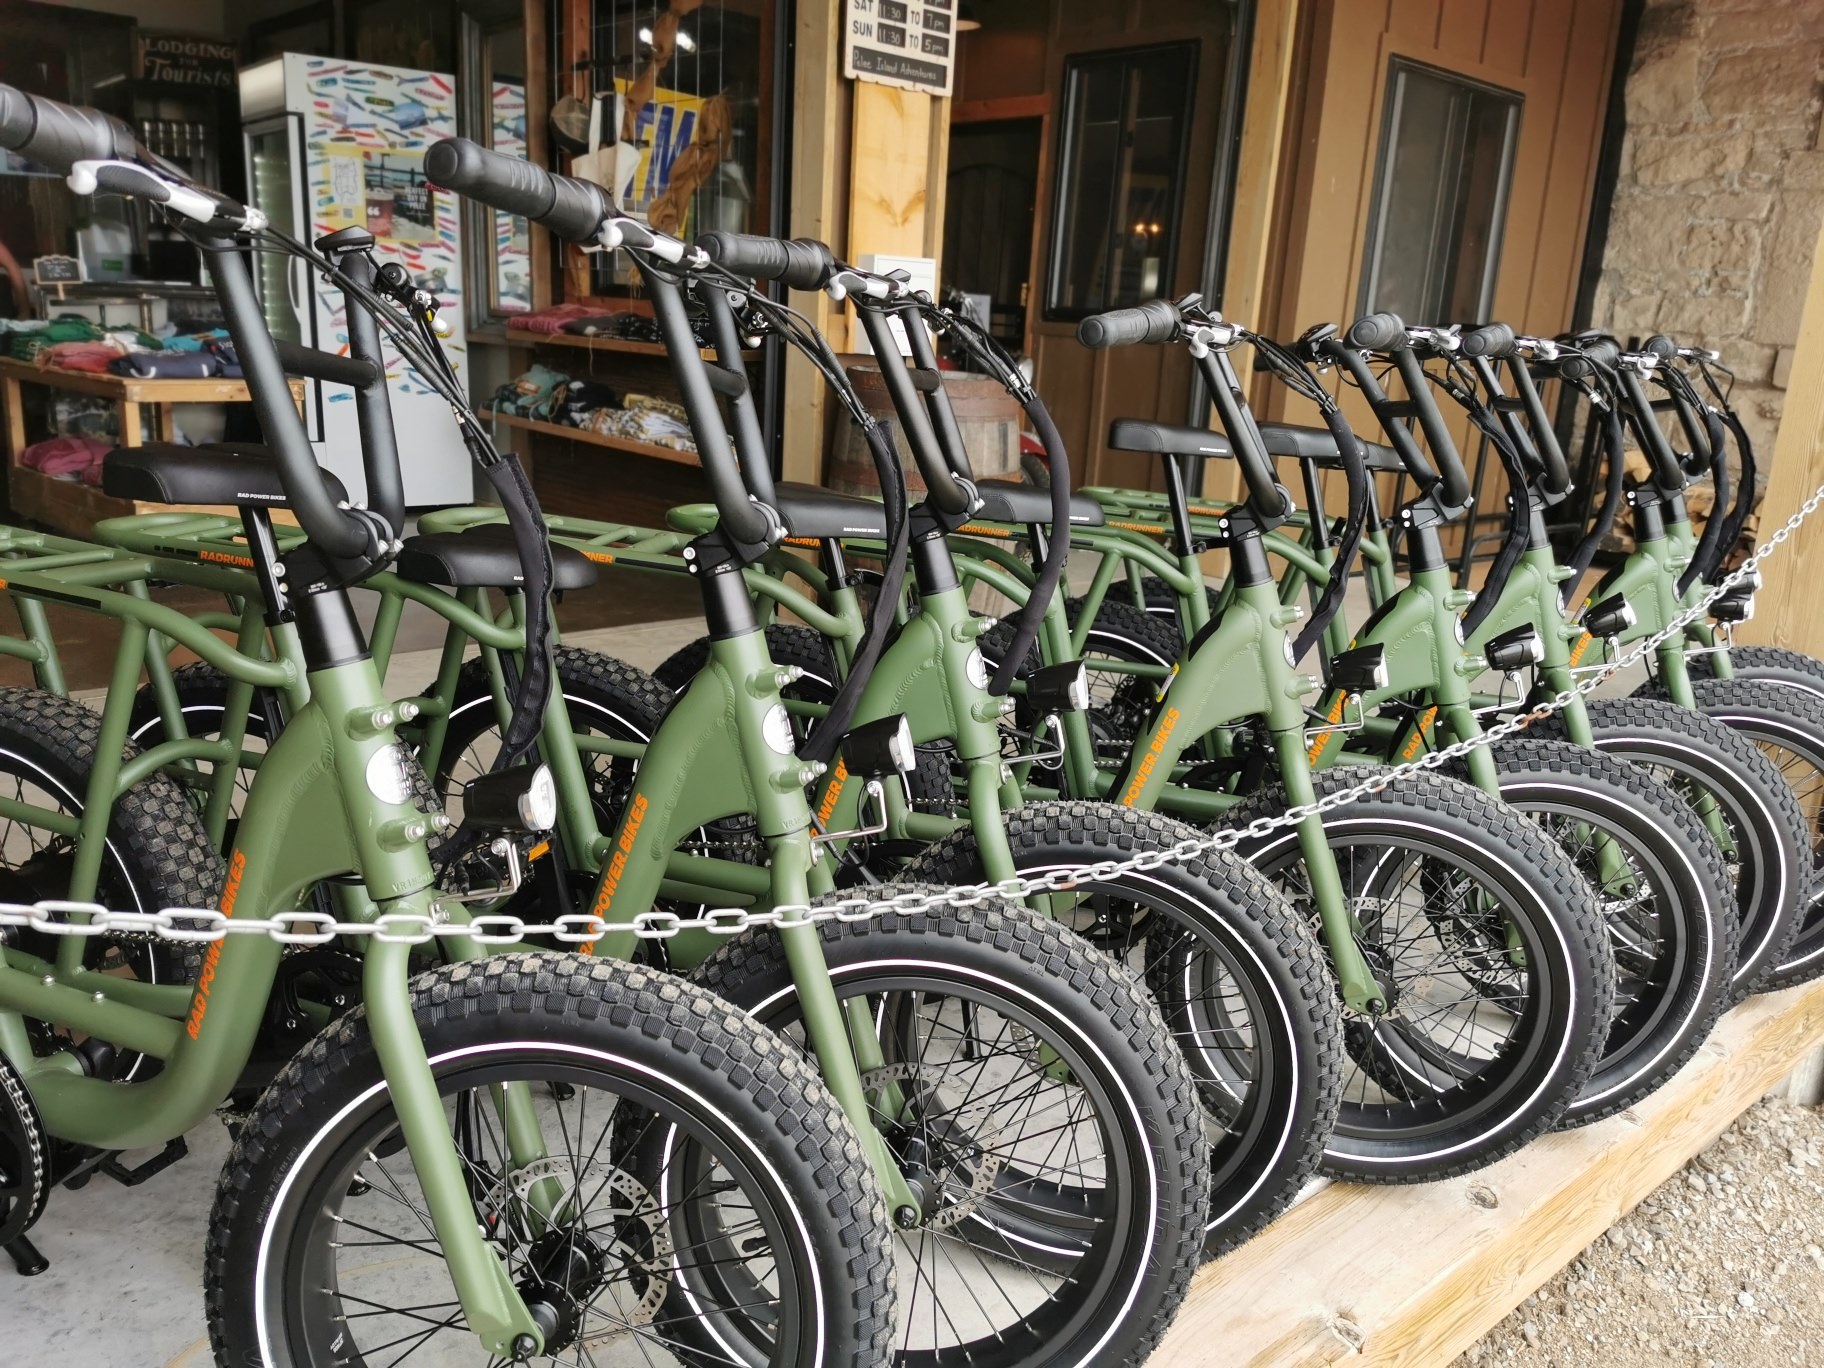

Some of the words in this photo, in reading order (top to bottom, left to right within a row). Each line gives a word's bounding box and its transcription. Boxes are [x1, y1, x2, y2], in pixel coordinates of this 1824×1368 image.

[853, 20, 873, 37] SUN
[909, 34, 919, 49] TO
[854, 0, 873, 12] SAT
[911, 10, 920, 25] TO
[200, 550, 255, 568] RADRUNN
[1122, 752, 1158, 809] POWER
[1150, 706, 1181, 755] BIKES
[1402, 732, 1423, 760] RAD
[1419, 705, 1438, 735] POW
[594, 850, 629, 918] POWER
[618, 792, 649, 855] BIKES
[186, 993, 208, 1041] RAD
[199, 936, 225, 996] POW
[220, 847, 246, 918] BIKES
